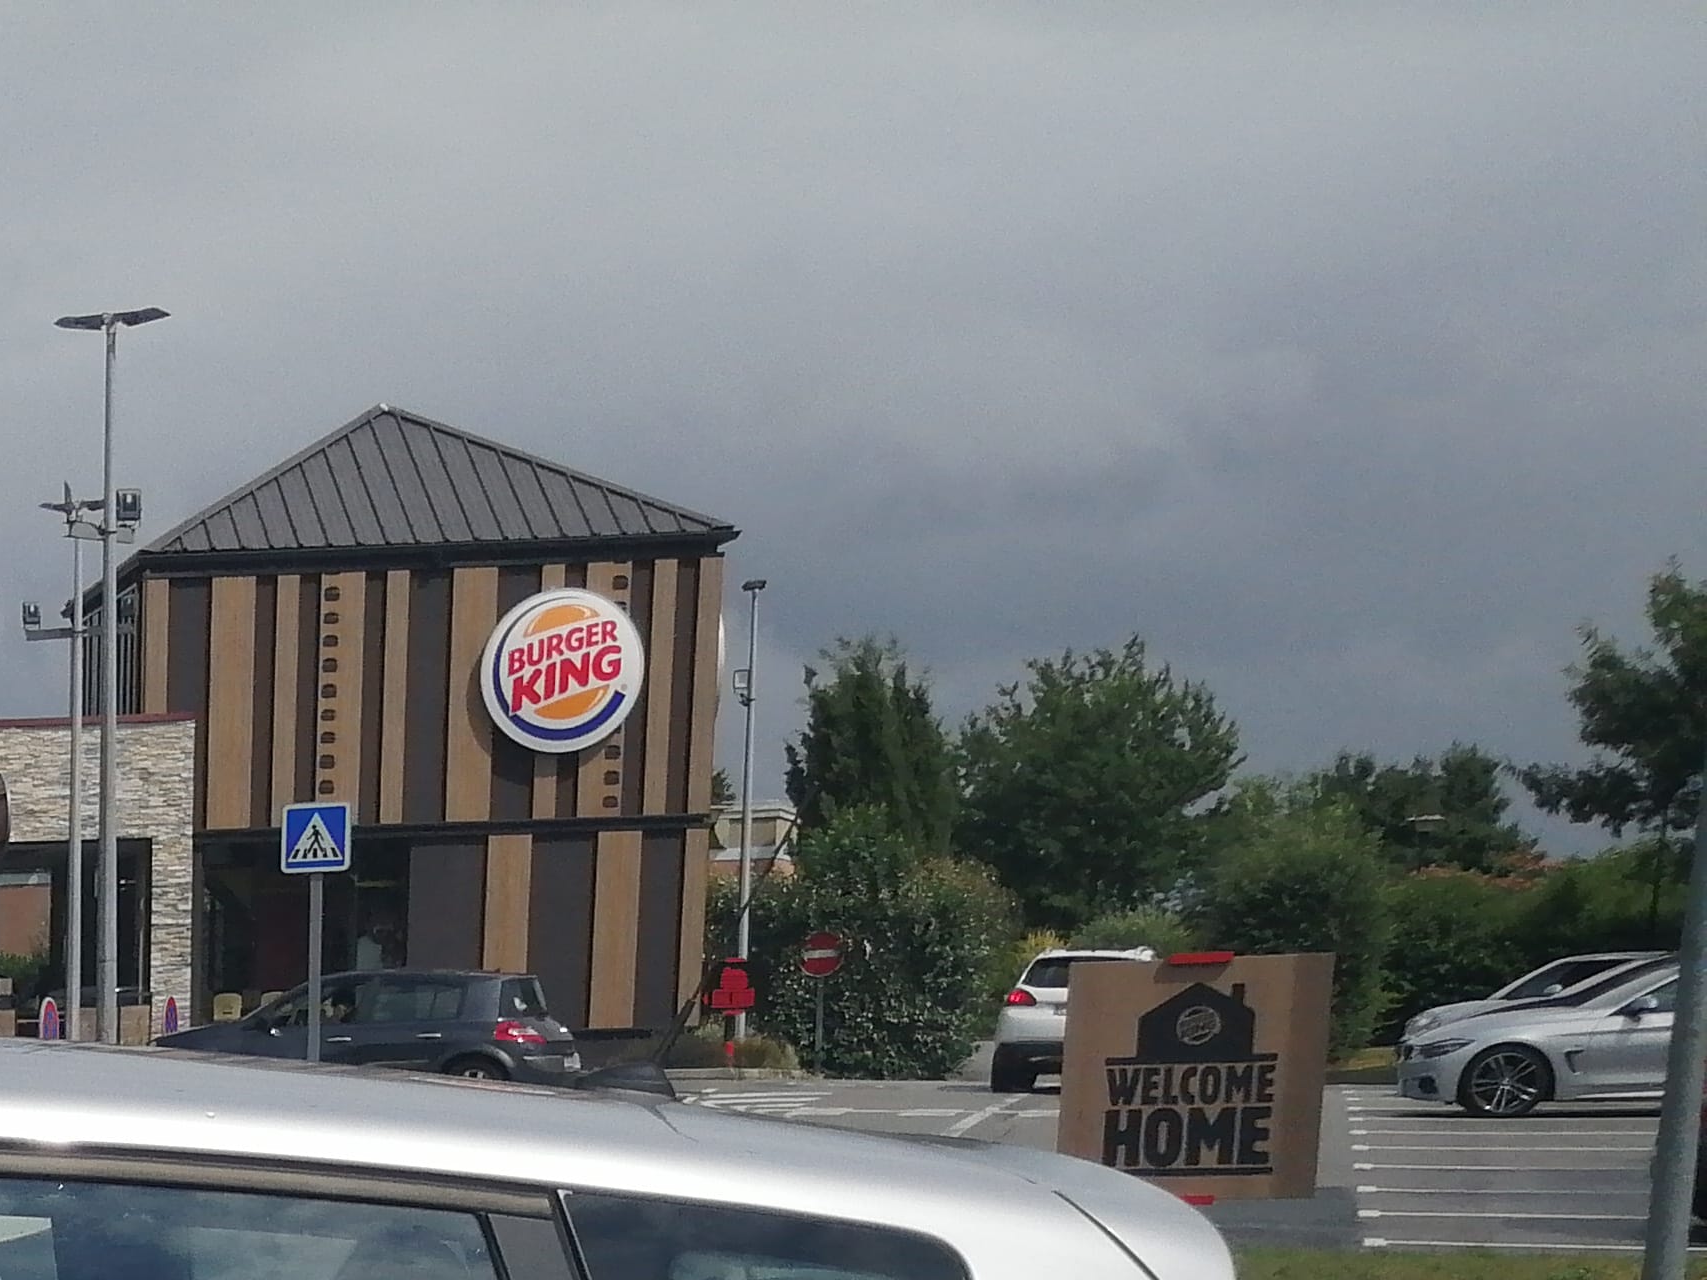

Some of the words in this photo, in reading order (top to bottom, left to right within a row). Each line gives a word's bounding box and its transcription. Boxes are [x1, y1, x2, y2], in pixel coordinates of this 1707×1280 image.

[508, 620, 618, 677] BURGER
[511, 645, 622, 713] KING
[1106, 1064, 1277, 1106] WELCOME
[1101, 1106, 1273, 1168] HOME
